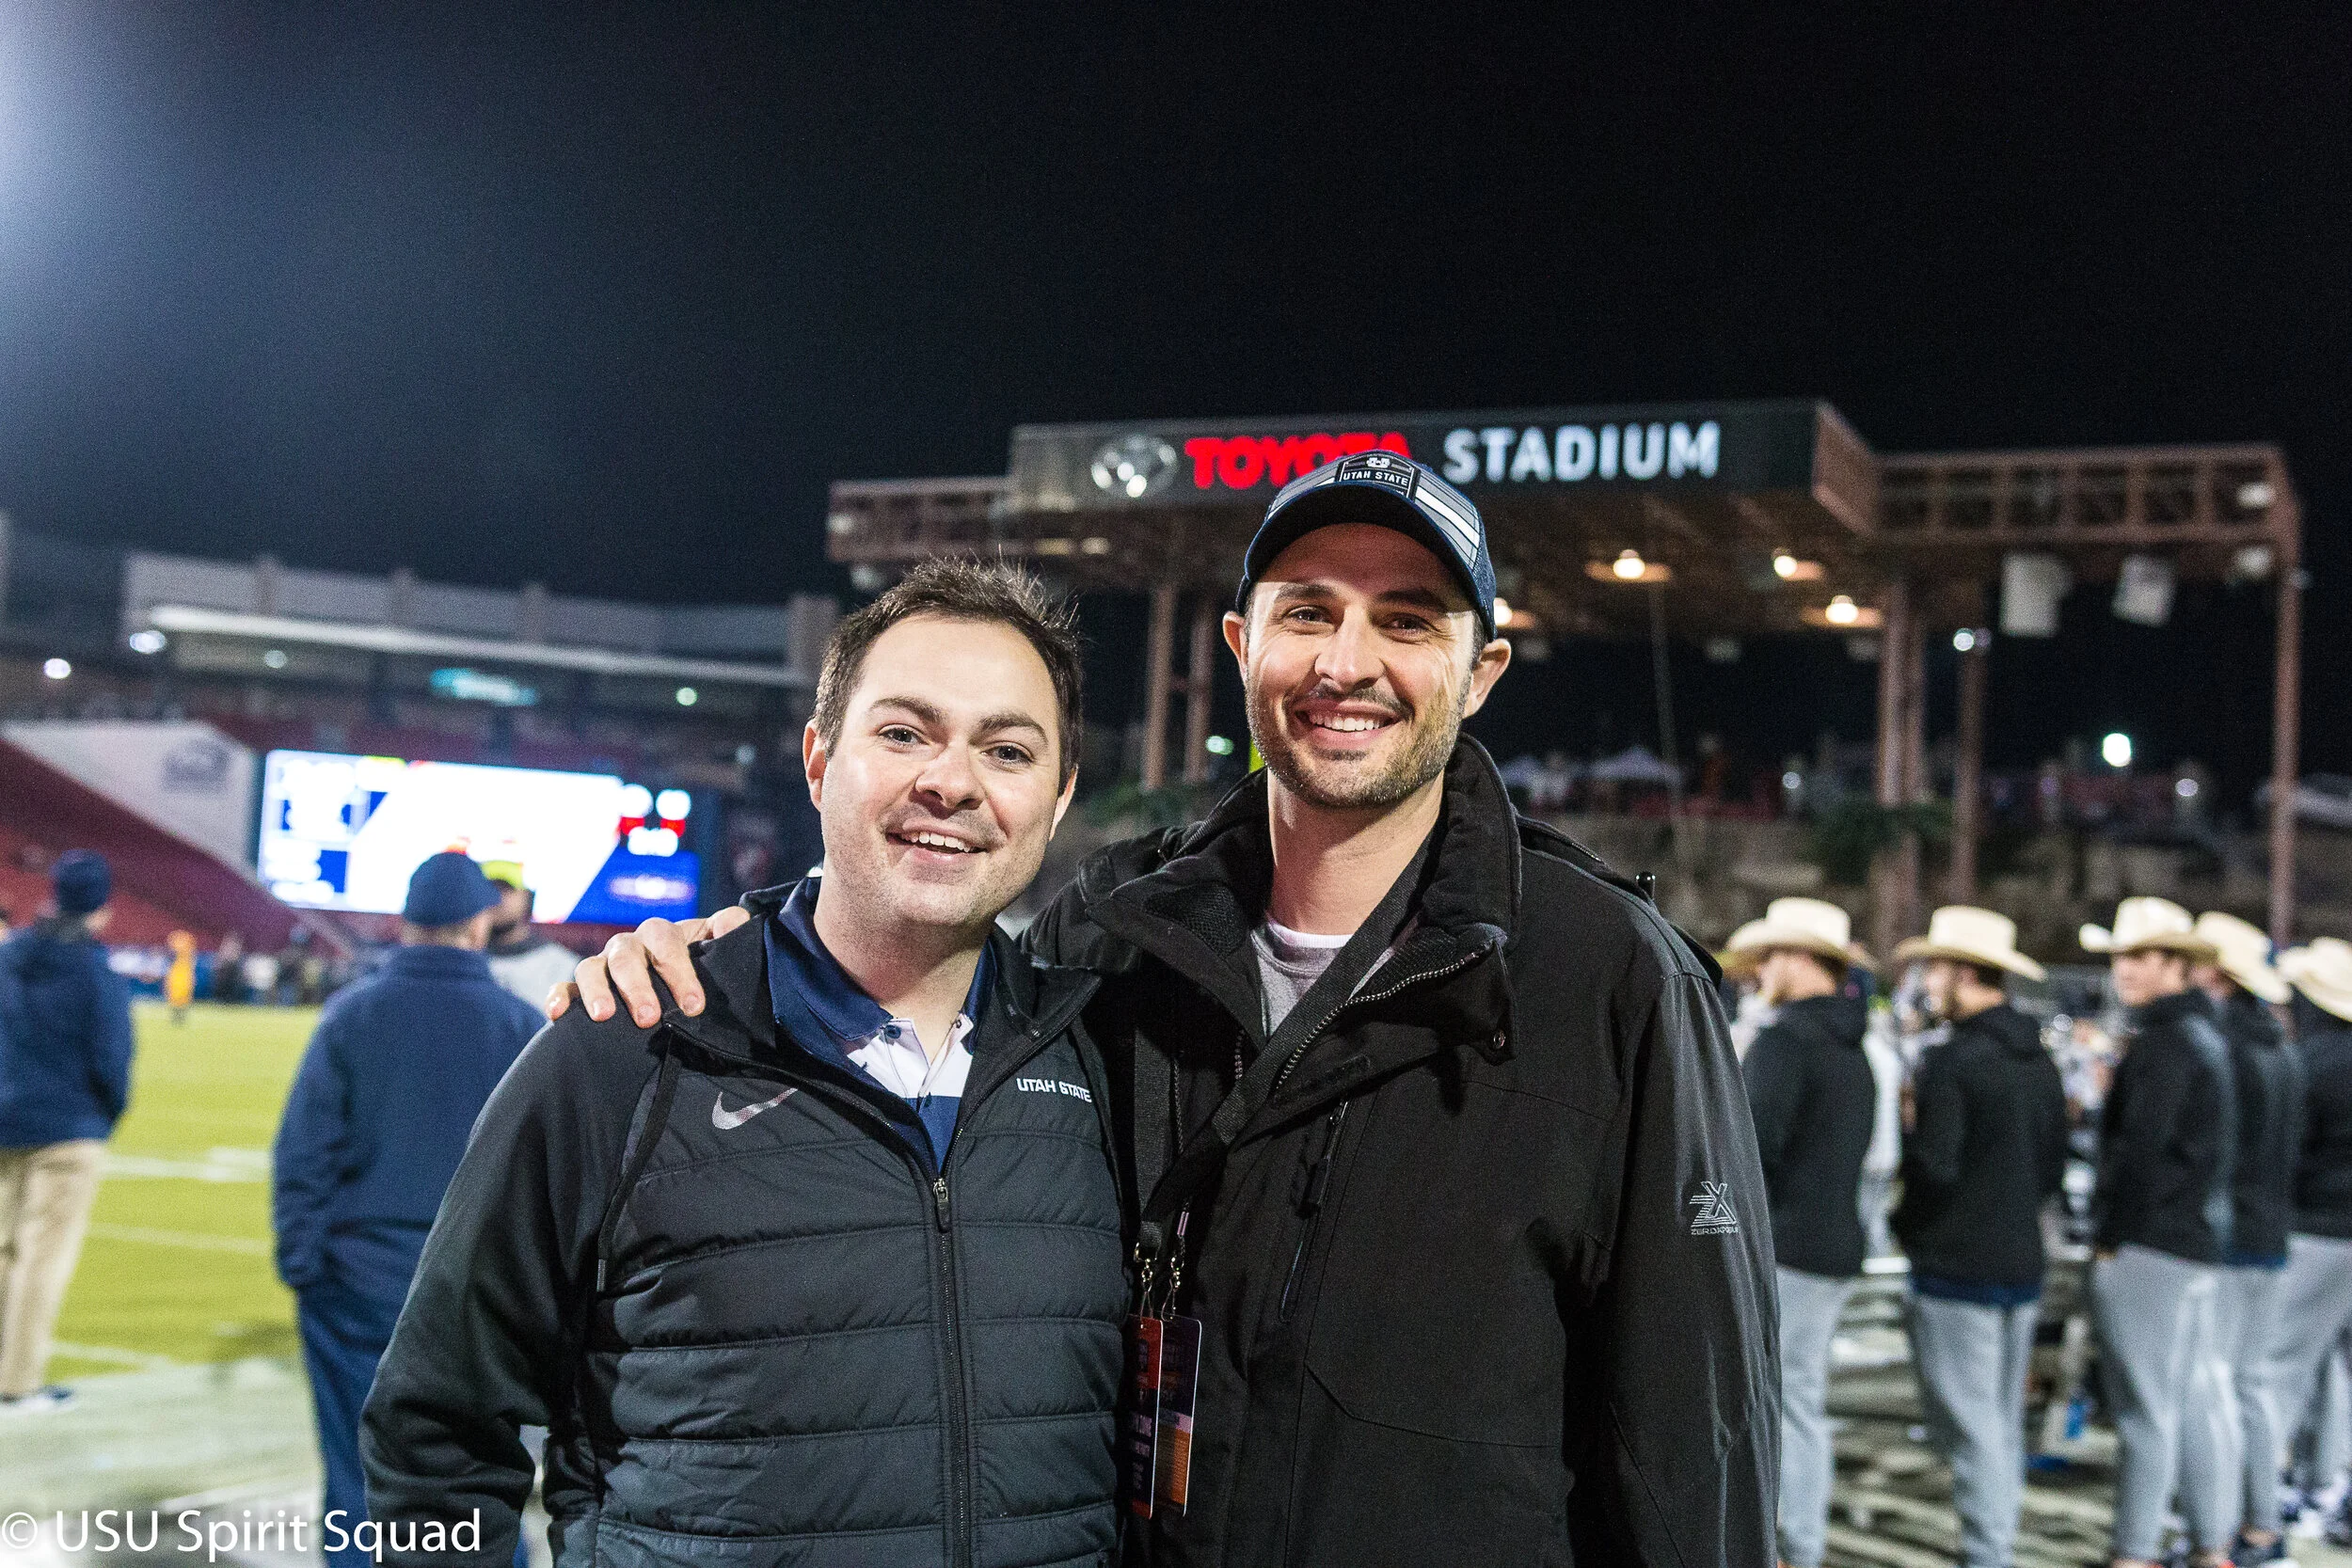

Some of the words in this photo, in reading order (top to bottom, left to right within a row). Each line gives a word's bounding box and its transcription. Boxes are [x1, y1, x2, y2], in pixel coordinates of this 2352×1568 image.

[1441, 420, 1721, 483] STADIUM
[1343, 470, 1371, 481] UTAH
[1375, 471, 1408, 485] STATE
[1016, 1078, 1056, 1093] UTAH
[1058, 1081, 1092, 1102] STATE
